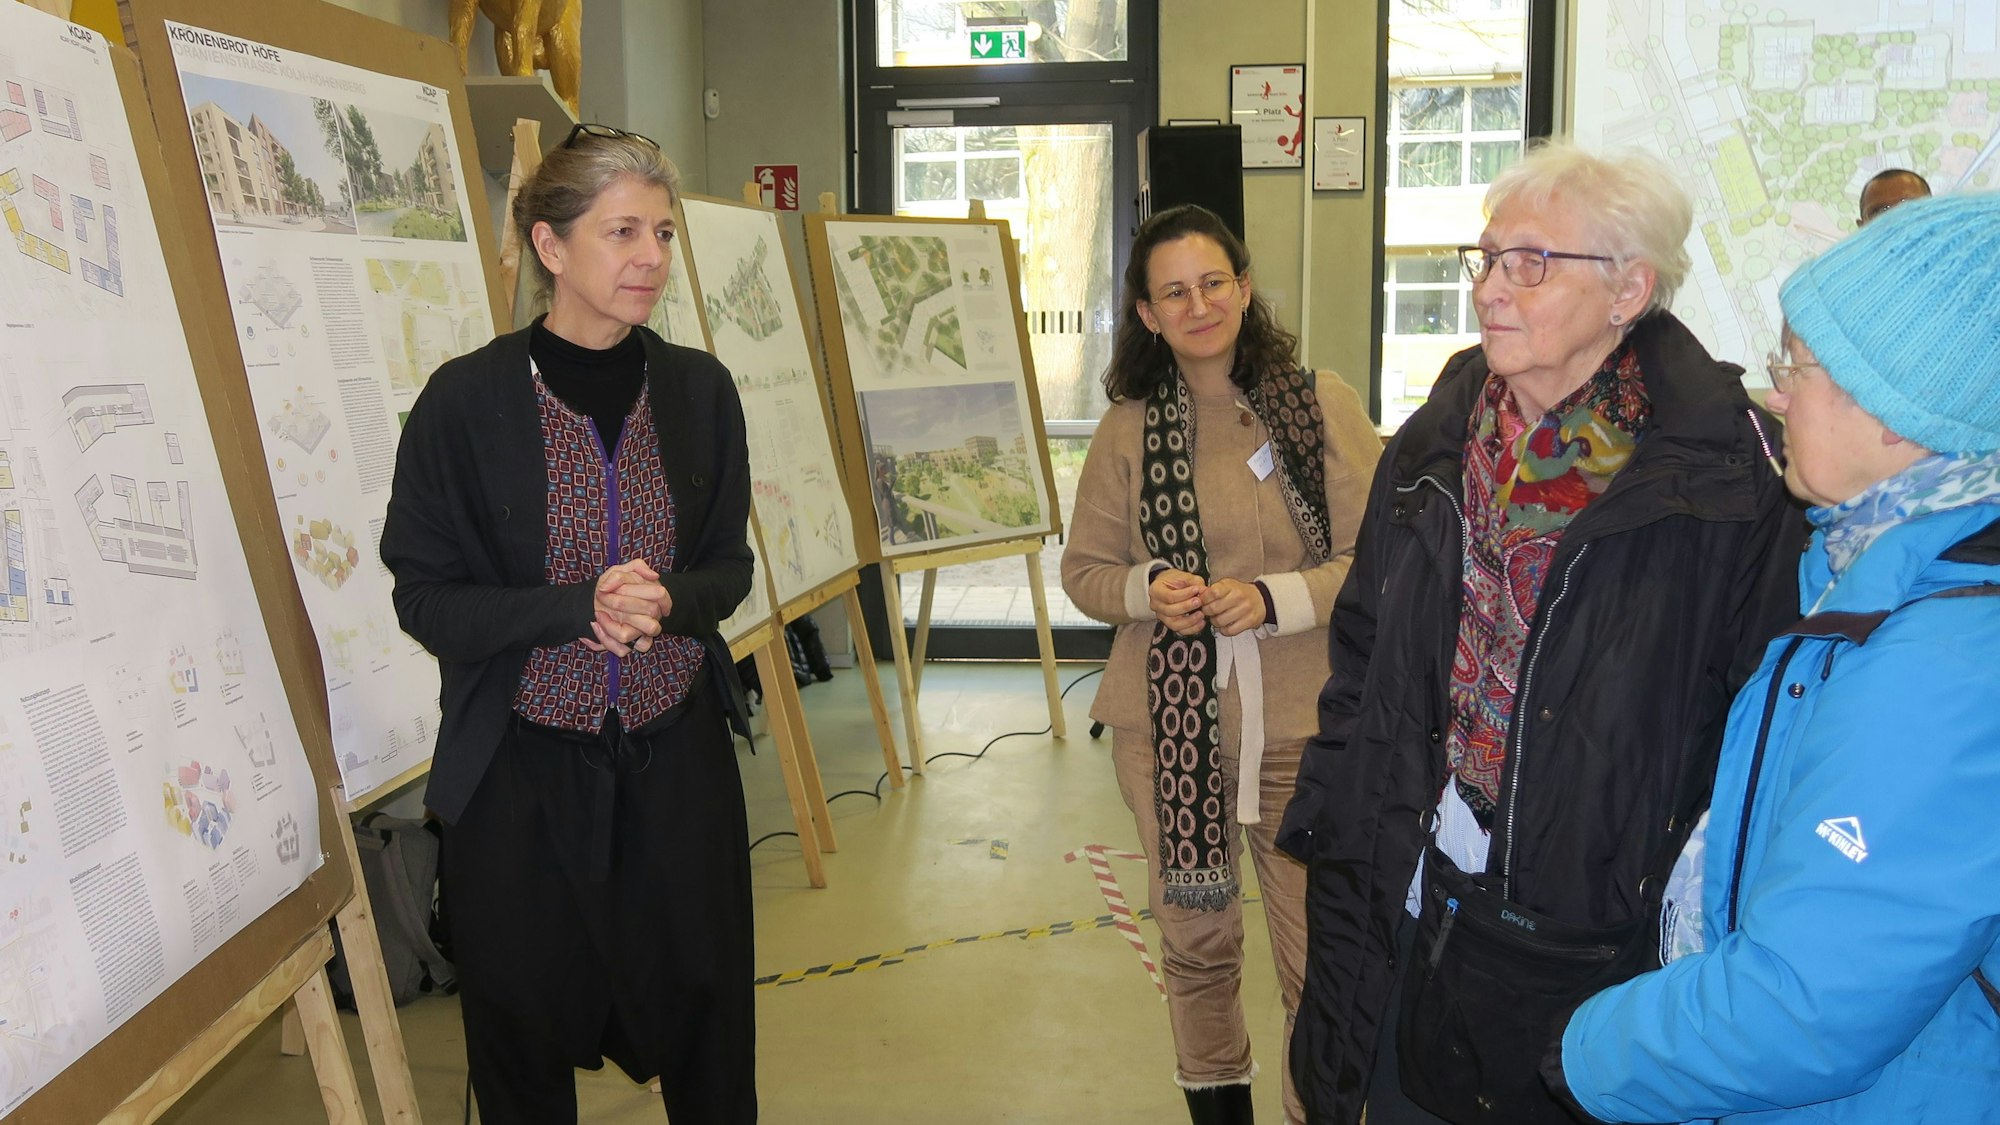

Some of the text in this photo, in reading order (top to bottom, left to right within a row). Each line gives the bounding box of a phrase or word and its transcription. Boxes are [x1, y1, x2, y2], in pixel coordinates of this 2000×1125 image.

[173, 43, 280, 76] ORANIENSTRASSE
[250, 44, 281, 63] HÖFE
[1263, 107, 1281, 115] Platz
